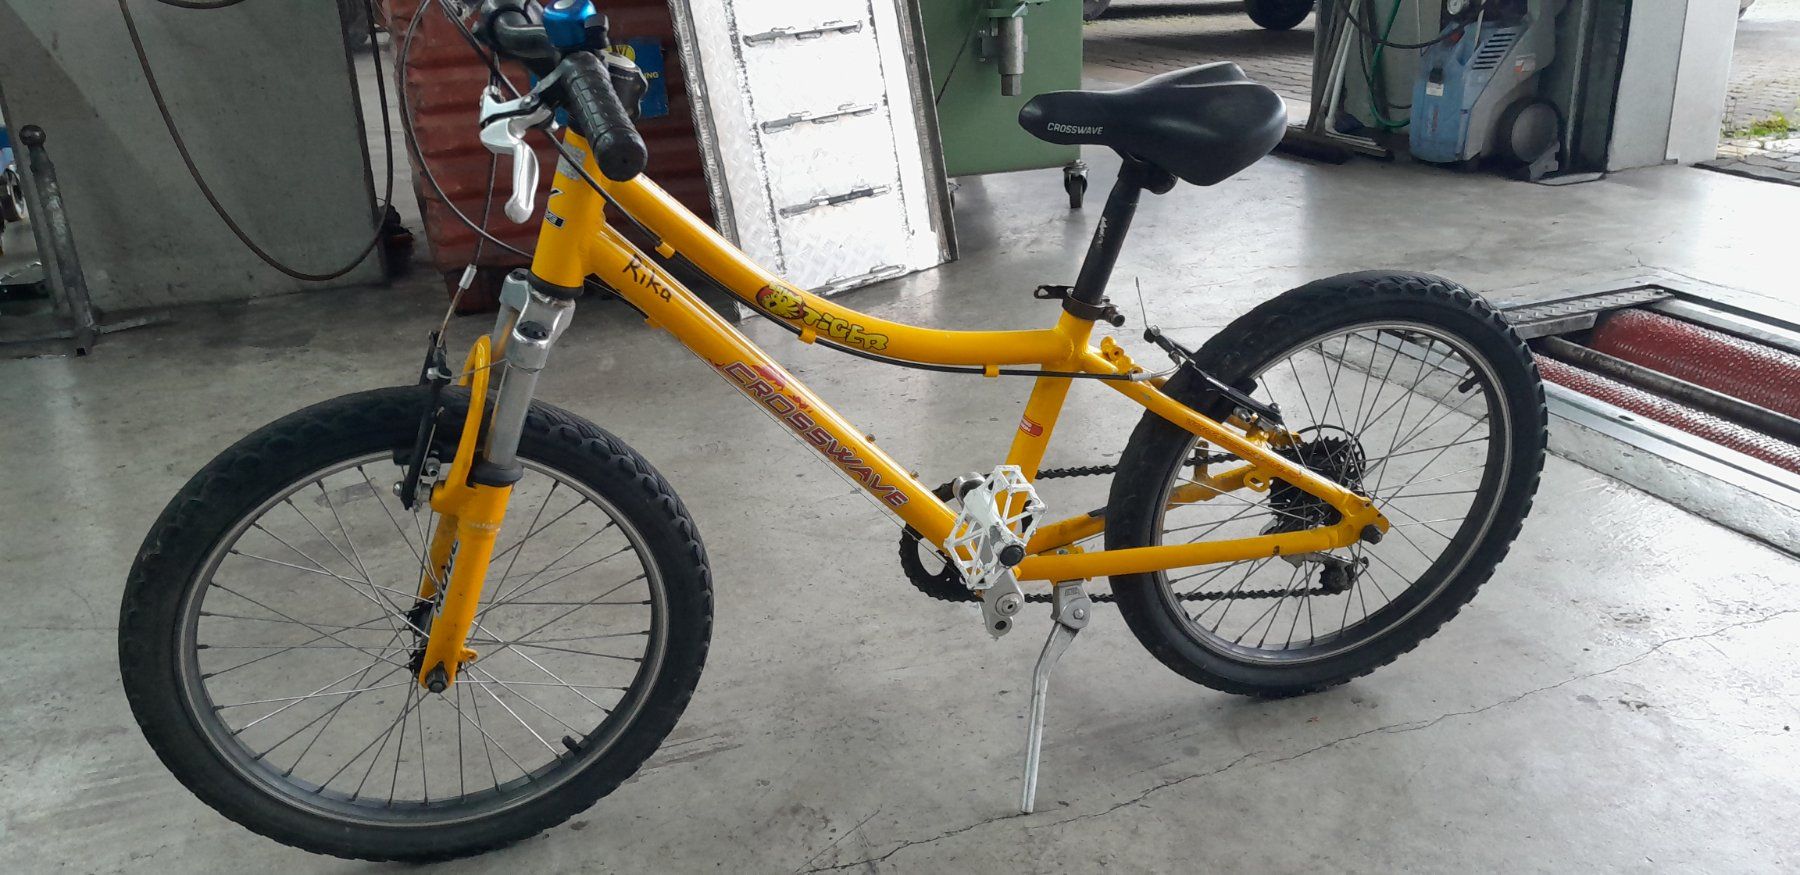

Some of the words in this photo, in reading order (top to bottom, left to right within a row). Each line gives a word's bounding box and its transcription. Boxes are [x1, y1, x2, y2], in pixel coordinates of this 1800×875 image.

[1047, 122, 1104, 135] CROSSWAVE
[622, 253, 673, 303] Rika
[723, 361, 911, 508] CROSSWAVE
